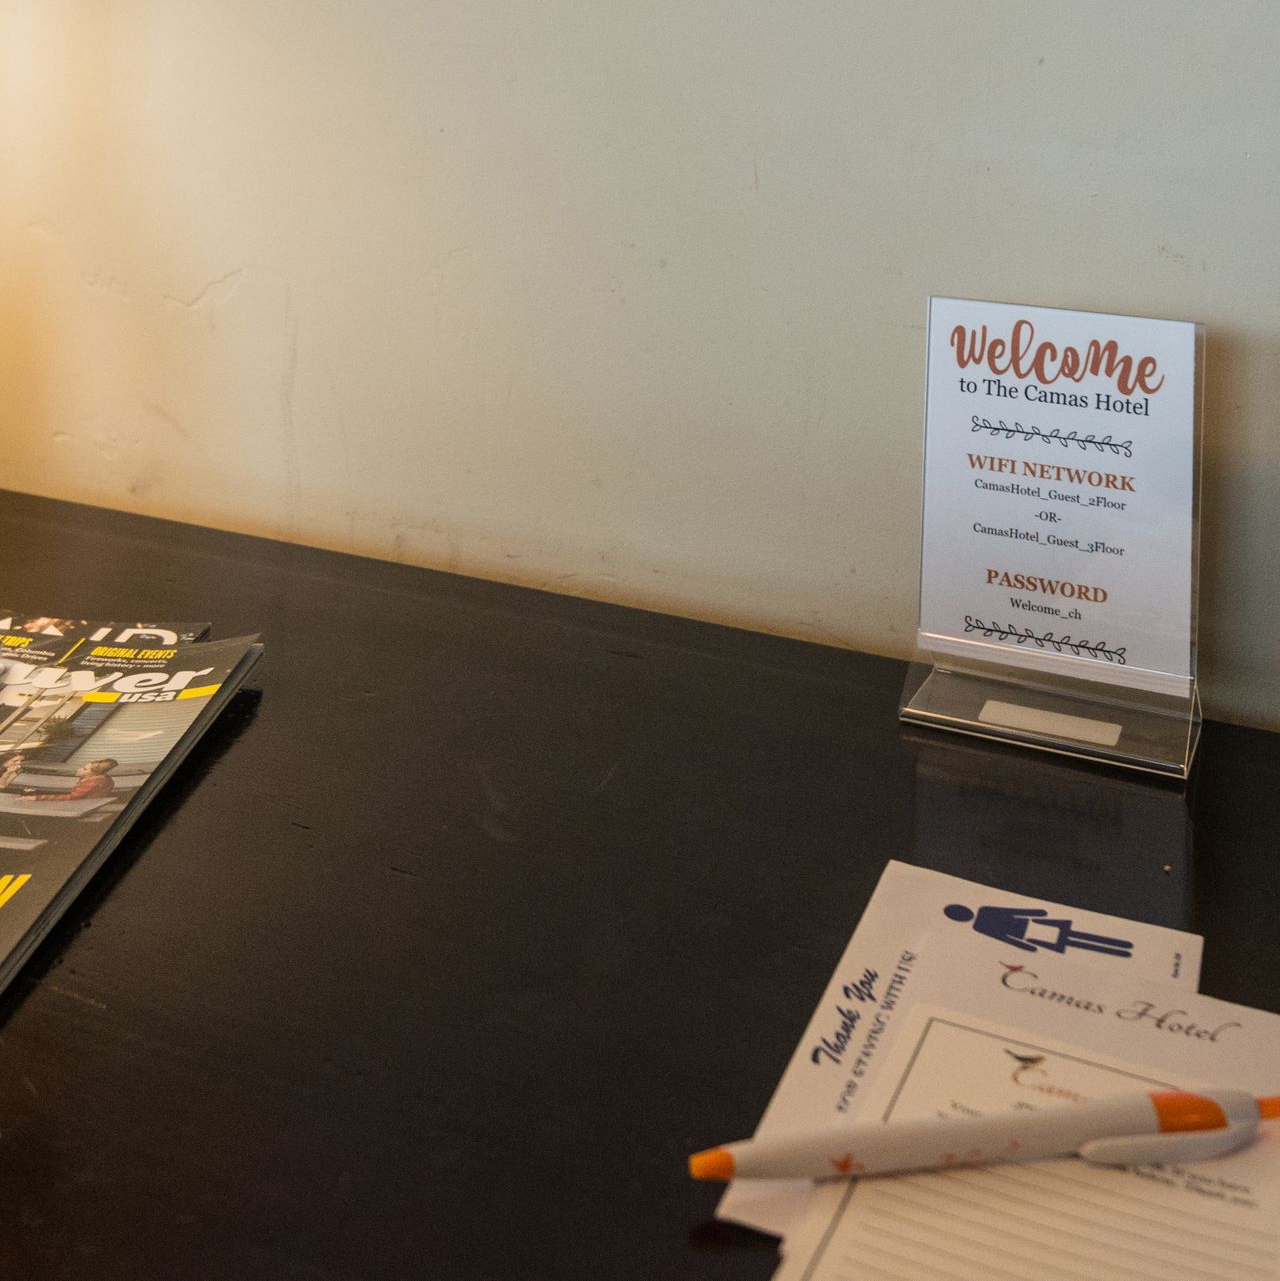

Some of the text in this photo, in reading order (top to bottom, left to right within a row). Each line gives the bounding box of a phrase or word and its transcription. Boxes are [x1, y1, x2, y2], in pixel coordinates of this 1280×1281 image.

[959, 377, 1150, 417] to The Camas Hotel
[966, 453, 1137, 493] WIFI NETWORK
[974, 478, 1127, 511] CamasHotel_Guest_2Floor
[1034, 510, 1062, 524] -OR-
[972, 522, 1125, 557] CamasHotel_Guest_3Floor
[986, 569, 1108, 603] PASSWORD
[1010, 597, 1082, 620] Welcome_ch
[1, 635, 34, 649] TRIPS
[90, 646, 178, 659] ORIGINAL EVENTS
[119, 689, 177, 703] usa
[811, 968, 879, 1065] Thank You
[1001, 969, 1244, 1043] Camas Hotel
